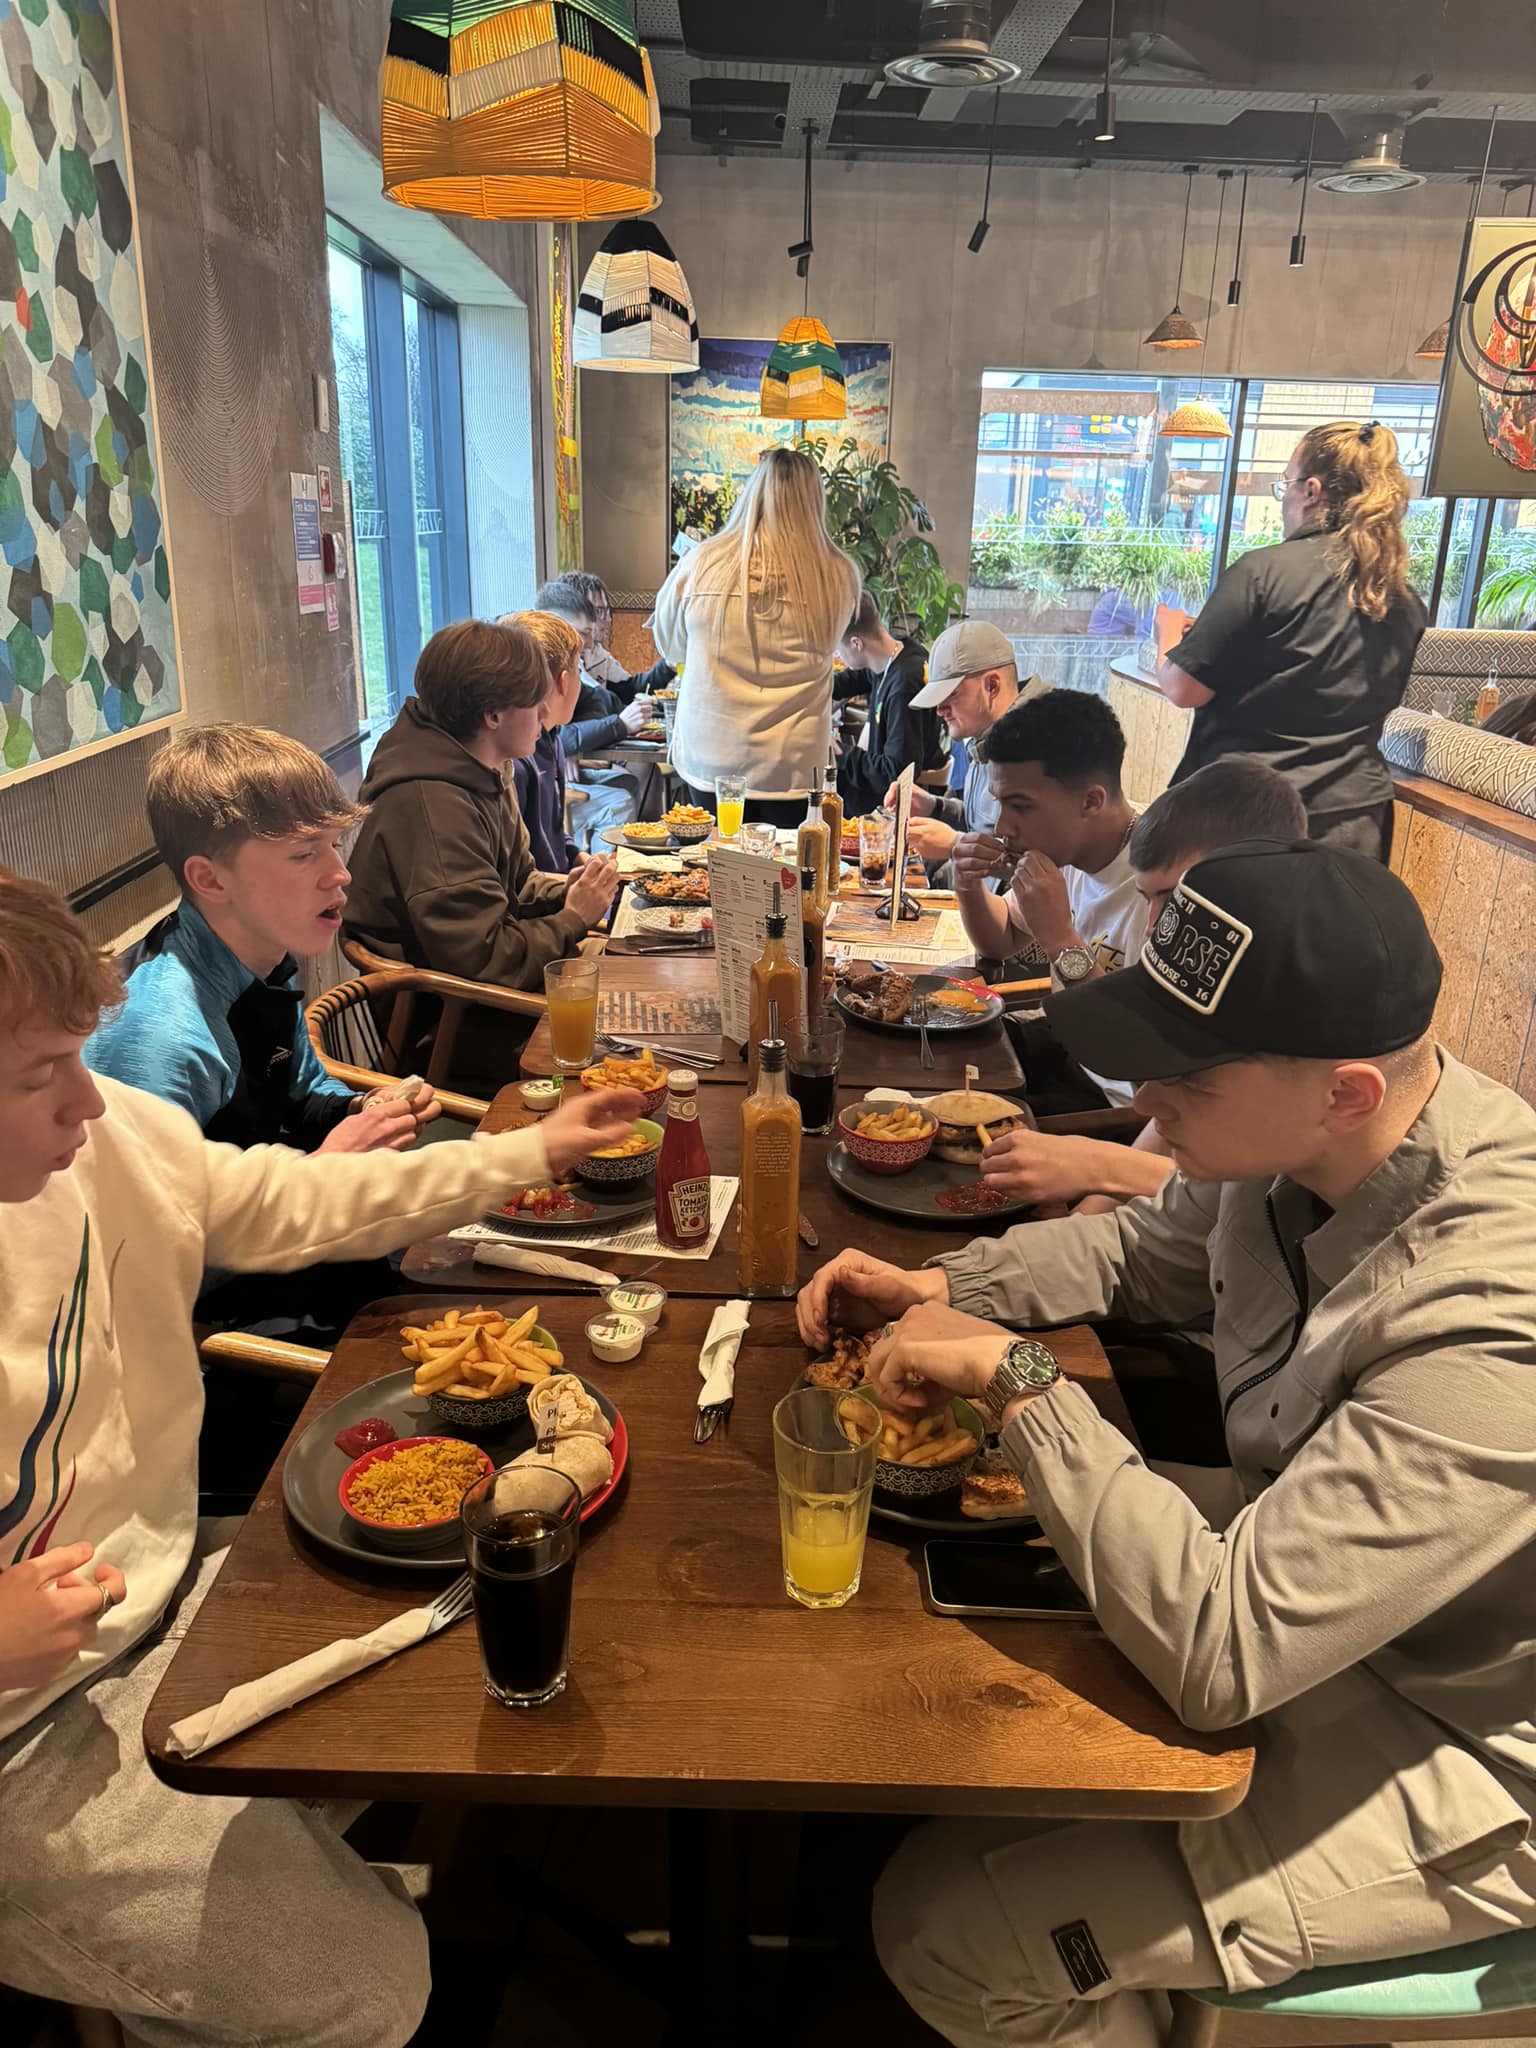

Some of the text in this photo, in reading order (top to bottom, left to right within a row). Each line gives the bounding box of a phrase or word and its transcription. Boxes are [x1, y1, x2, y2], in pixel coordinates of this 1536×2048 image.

[1156, 960, 1181, 984] ROSE
[1195, 988, 1210, 1001] 16
[682, 1182, 708, 1195] HEINZ
[679, 1194, 708, 1207] TOMATO
